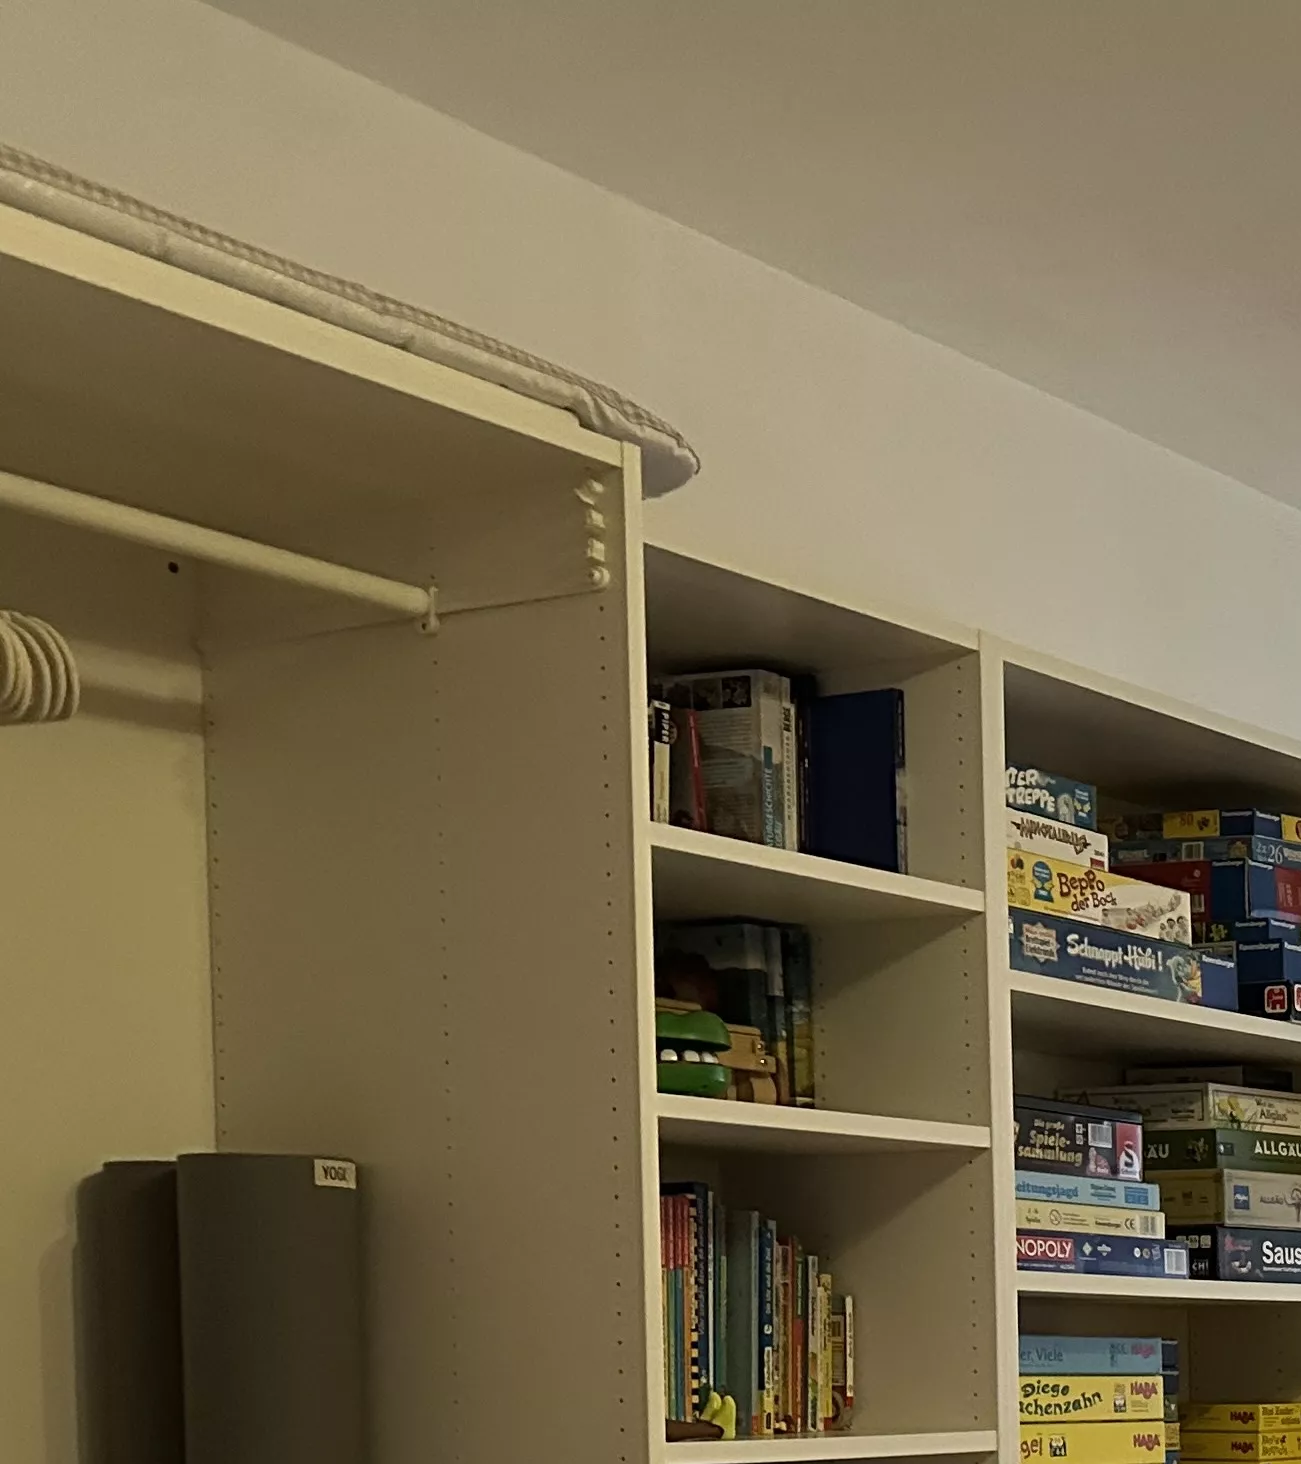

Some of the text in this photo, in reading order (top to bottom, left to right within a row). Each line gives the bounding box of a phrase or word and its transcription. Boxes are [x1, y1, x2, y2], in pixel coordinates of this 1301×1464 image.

[661, 711, 670, 744] PIPER
[1006, 787, 1055, 812] TREPPE
[1071, 892, 1118, 912] der Bock
[1067, 933, 1122, 968] Schnappt
[1029, 1130, 1071, 1149] Spiele-
[1018, 1145, 1083, 1167] sammlung
[1015, 1238, 1073, 1259] NOPOLY
[1021, 1379, 1070, 1398] Diego
[1130, 1381, 1159, 1400] HABA
[1230, 1410, 1256, 1424] HABA
[1020, 1436, 1044, 1460] gel
[1133, 1433, 1161, 1451] HABA
[1231, 1441, 1255, 1454] HABA
